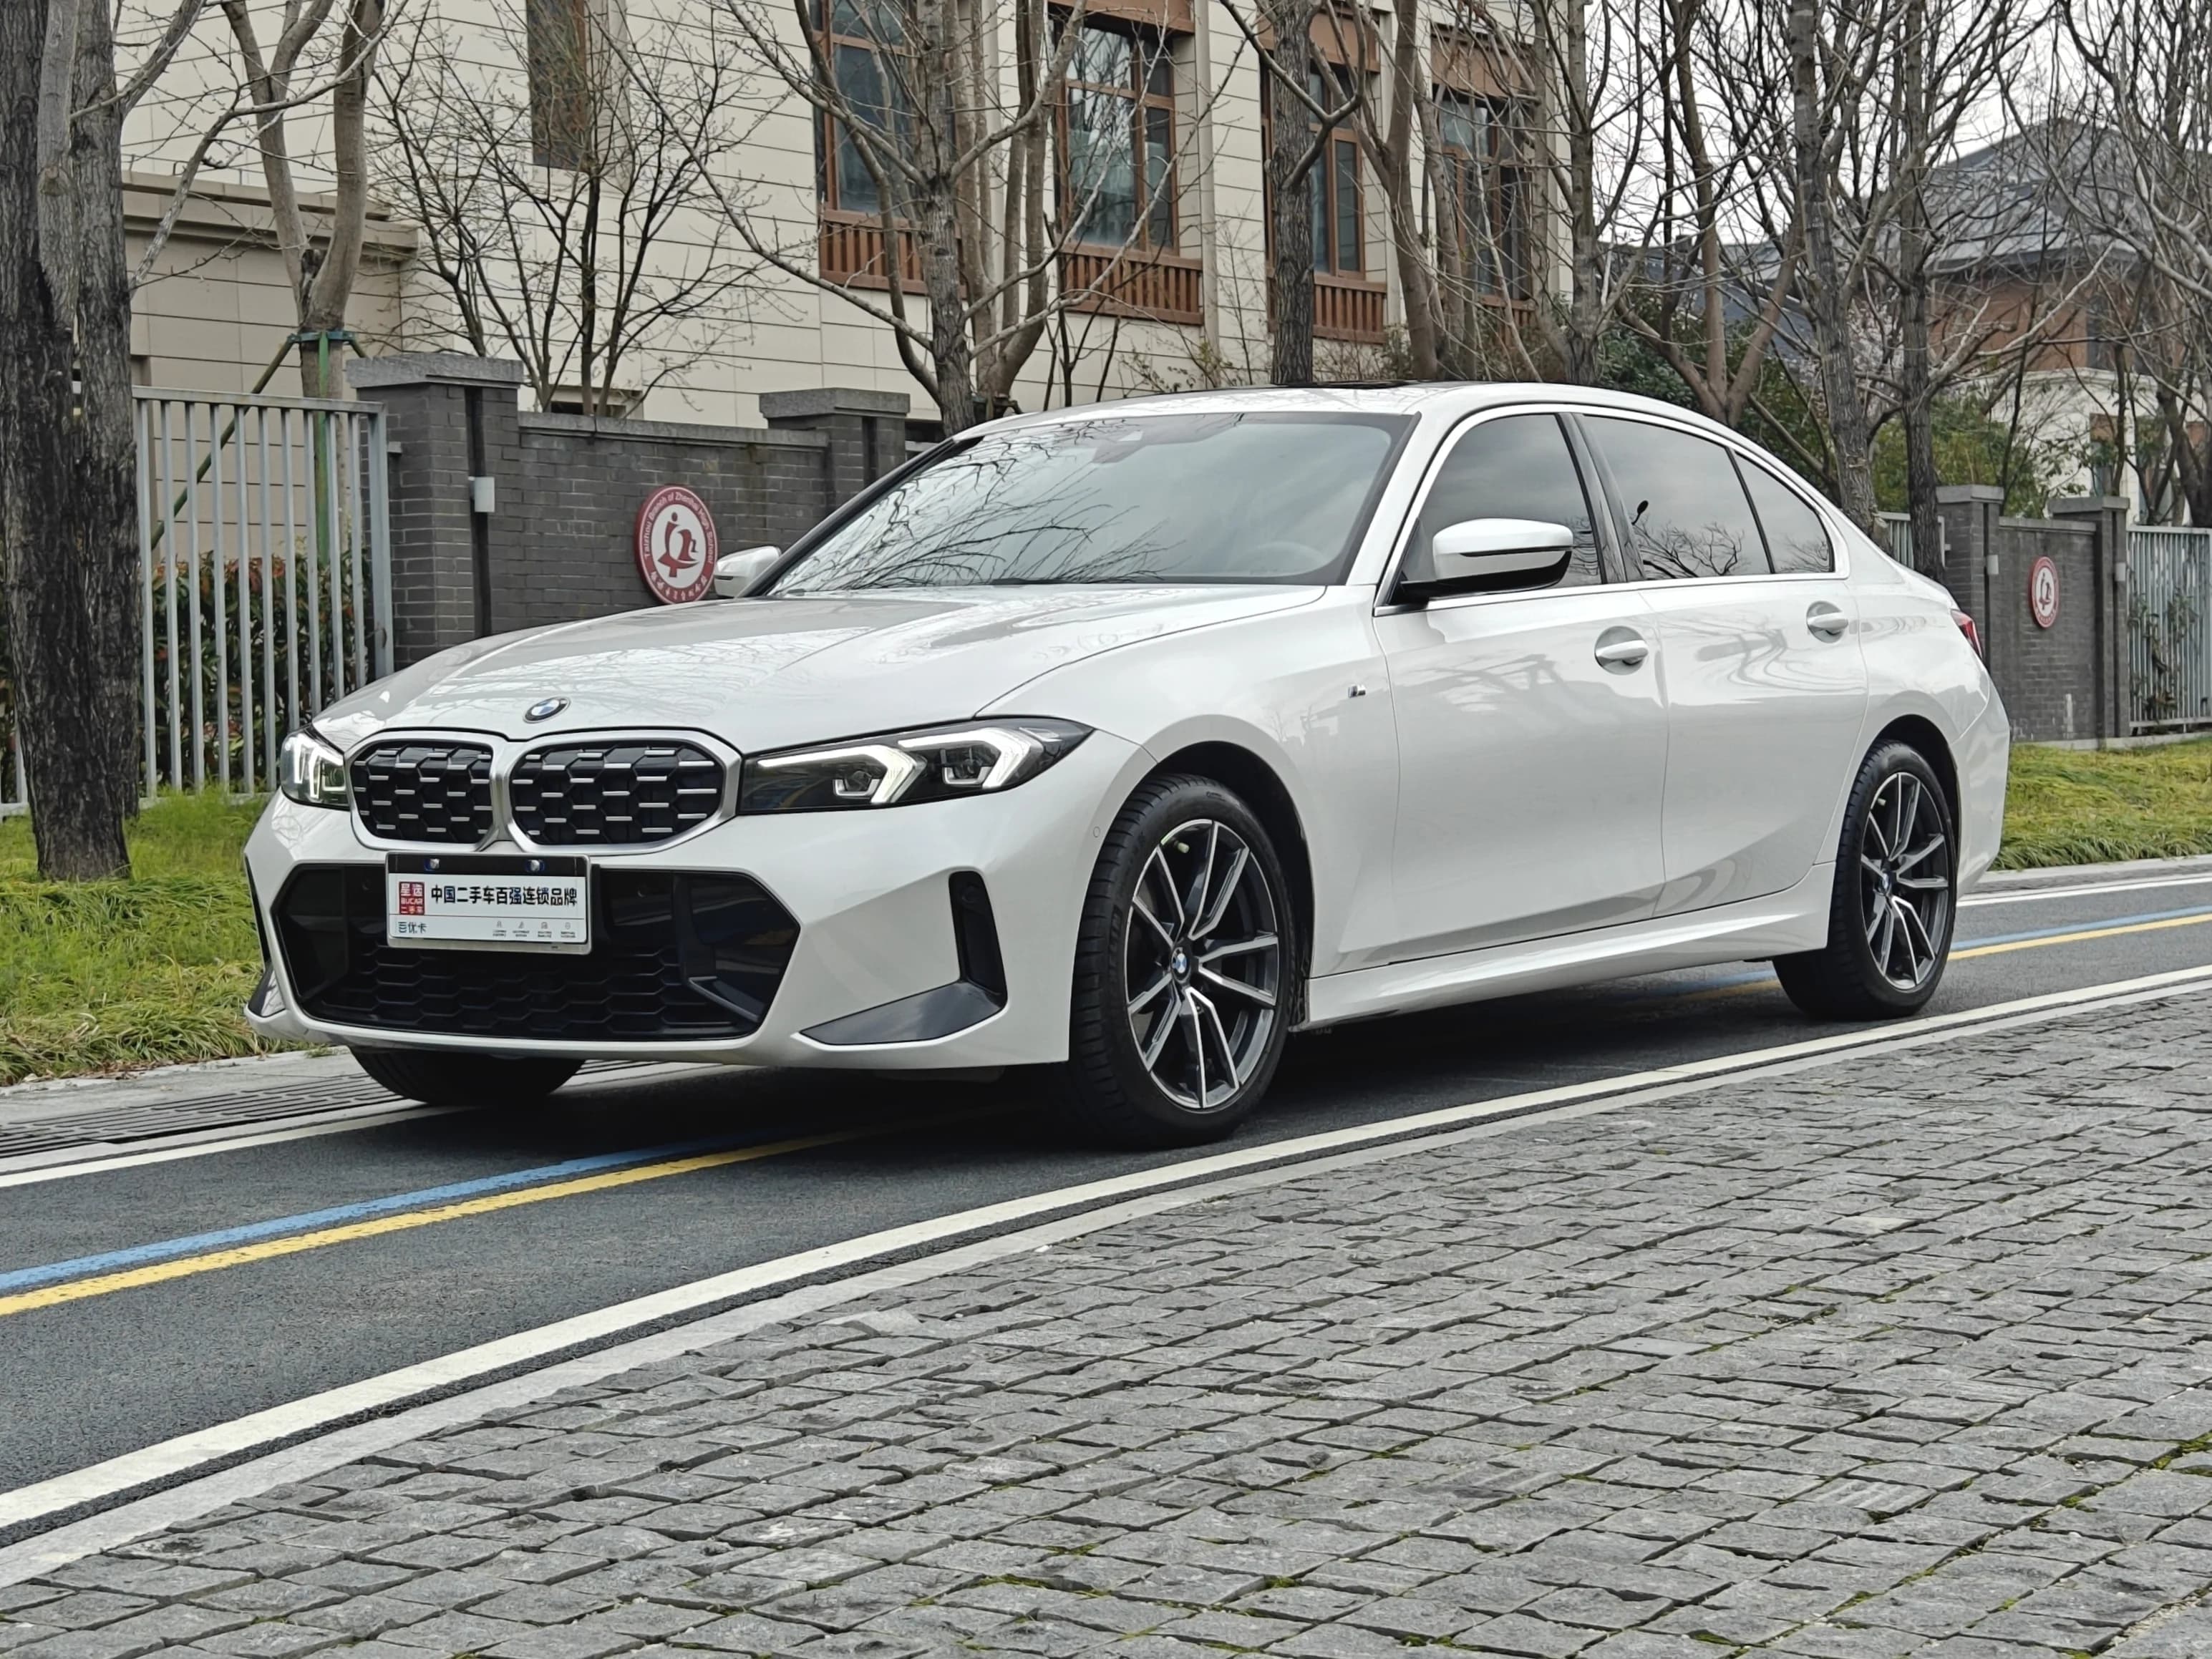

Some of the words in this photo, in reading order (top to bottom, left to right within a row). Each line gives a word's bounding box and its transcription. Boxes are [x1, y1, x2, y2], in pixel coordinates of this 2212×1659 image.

[431, 884, 577, 907] 中国二手车百强连锁品牌
